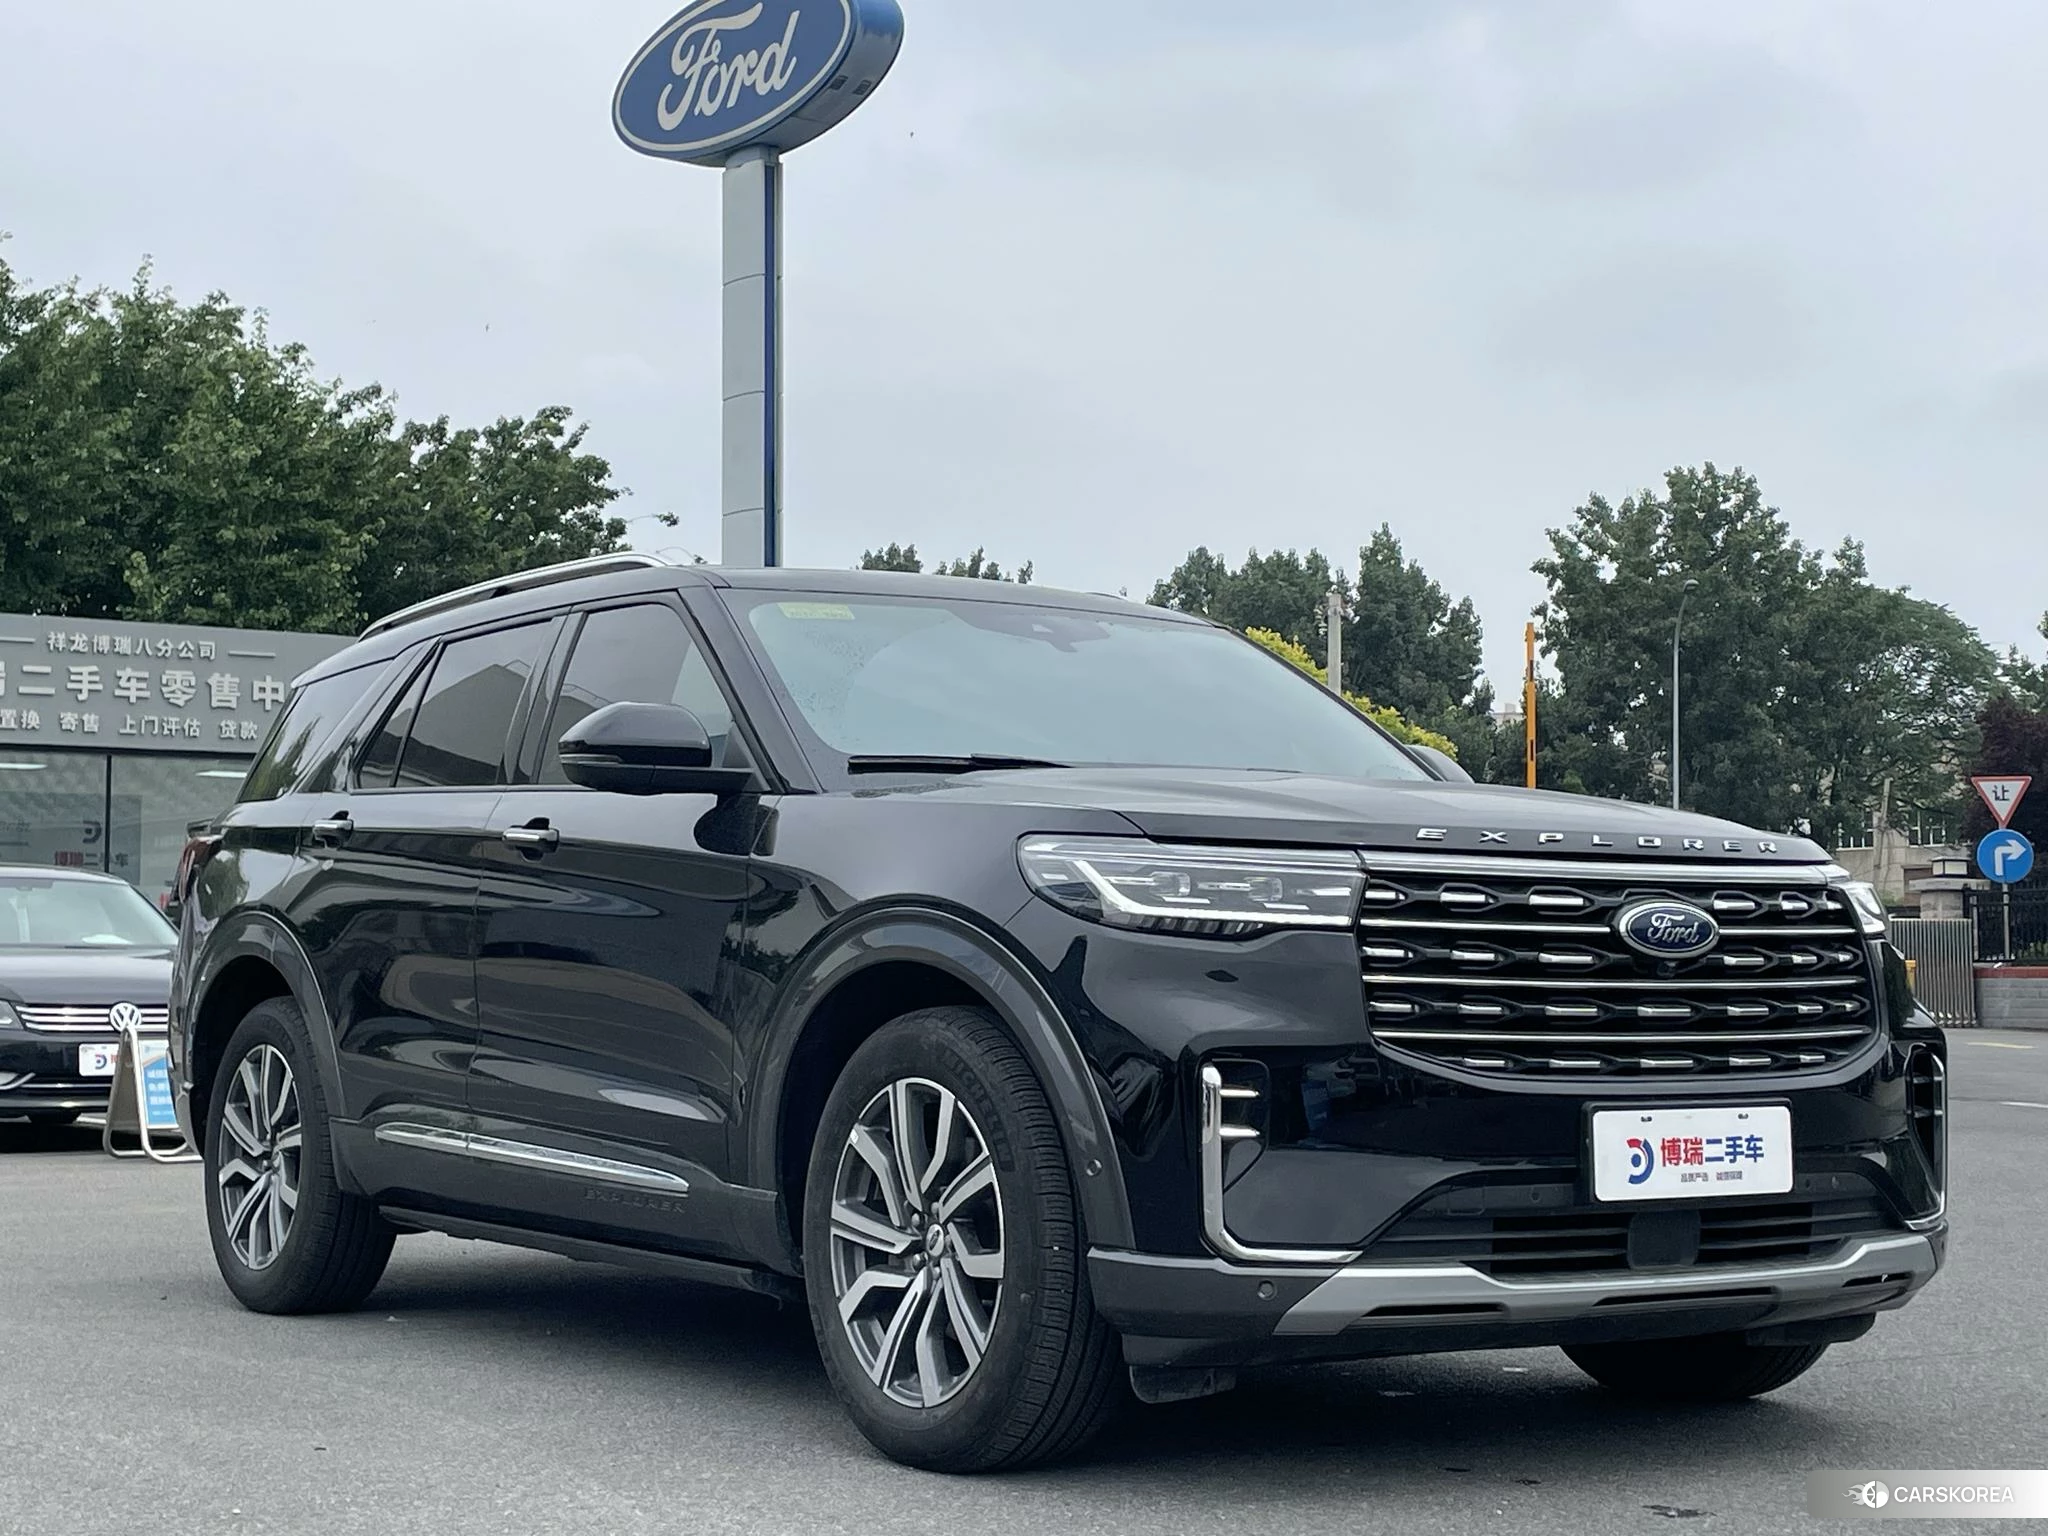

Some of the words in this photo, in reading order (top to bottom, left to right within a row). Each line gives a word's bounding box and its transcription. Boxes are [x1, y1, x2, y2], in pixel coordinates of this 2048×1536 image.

[657, 2, 800, 131] Ford
[47, 631, 217, 661] 祥龙博瑞八分公司
[0, 661, 286, 711] 二手车零售中
[60, 711, 100, 733] 寄售
[119, 715, 201, 738] 上门评估
[219, 719, 258, 740] 贷款
[1992, 784, 2010, 801] 让
[1416, 827, 1778, 852] EXPLORER
[1647, 913, 1700, 944] Ford
[1660, 1134, 1765, 1167] 博瑞二手车
